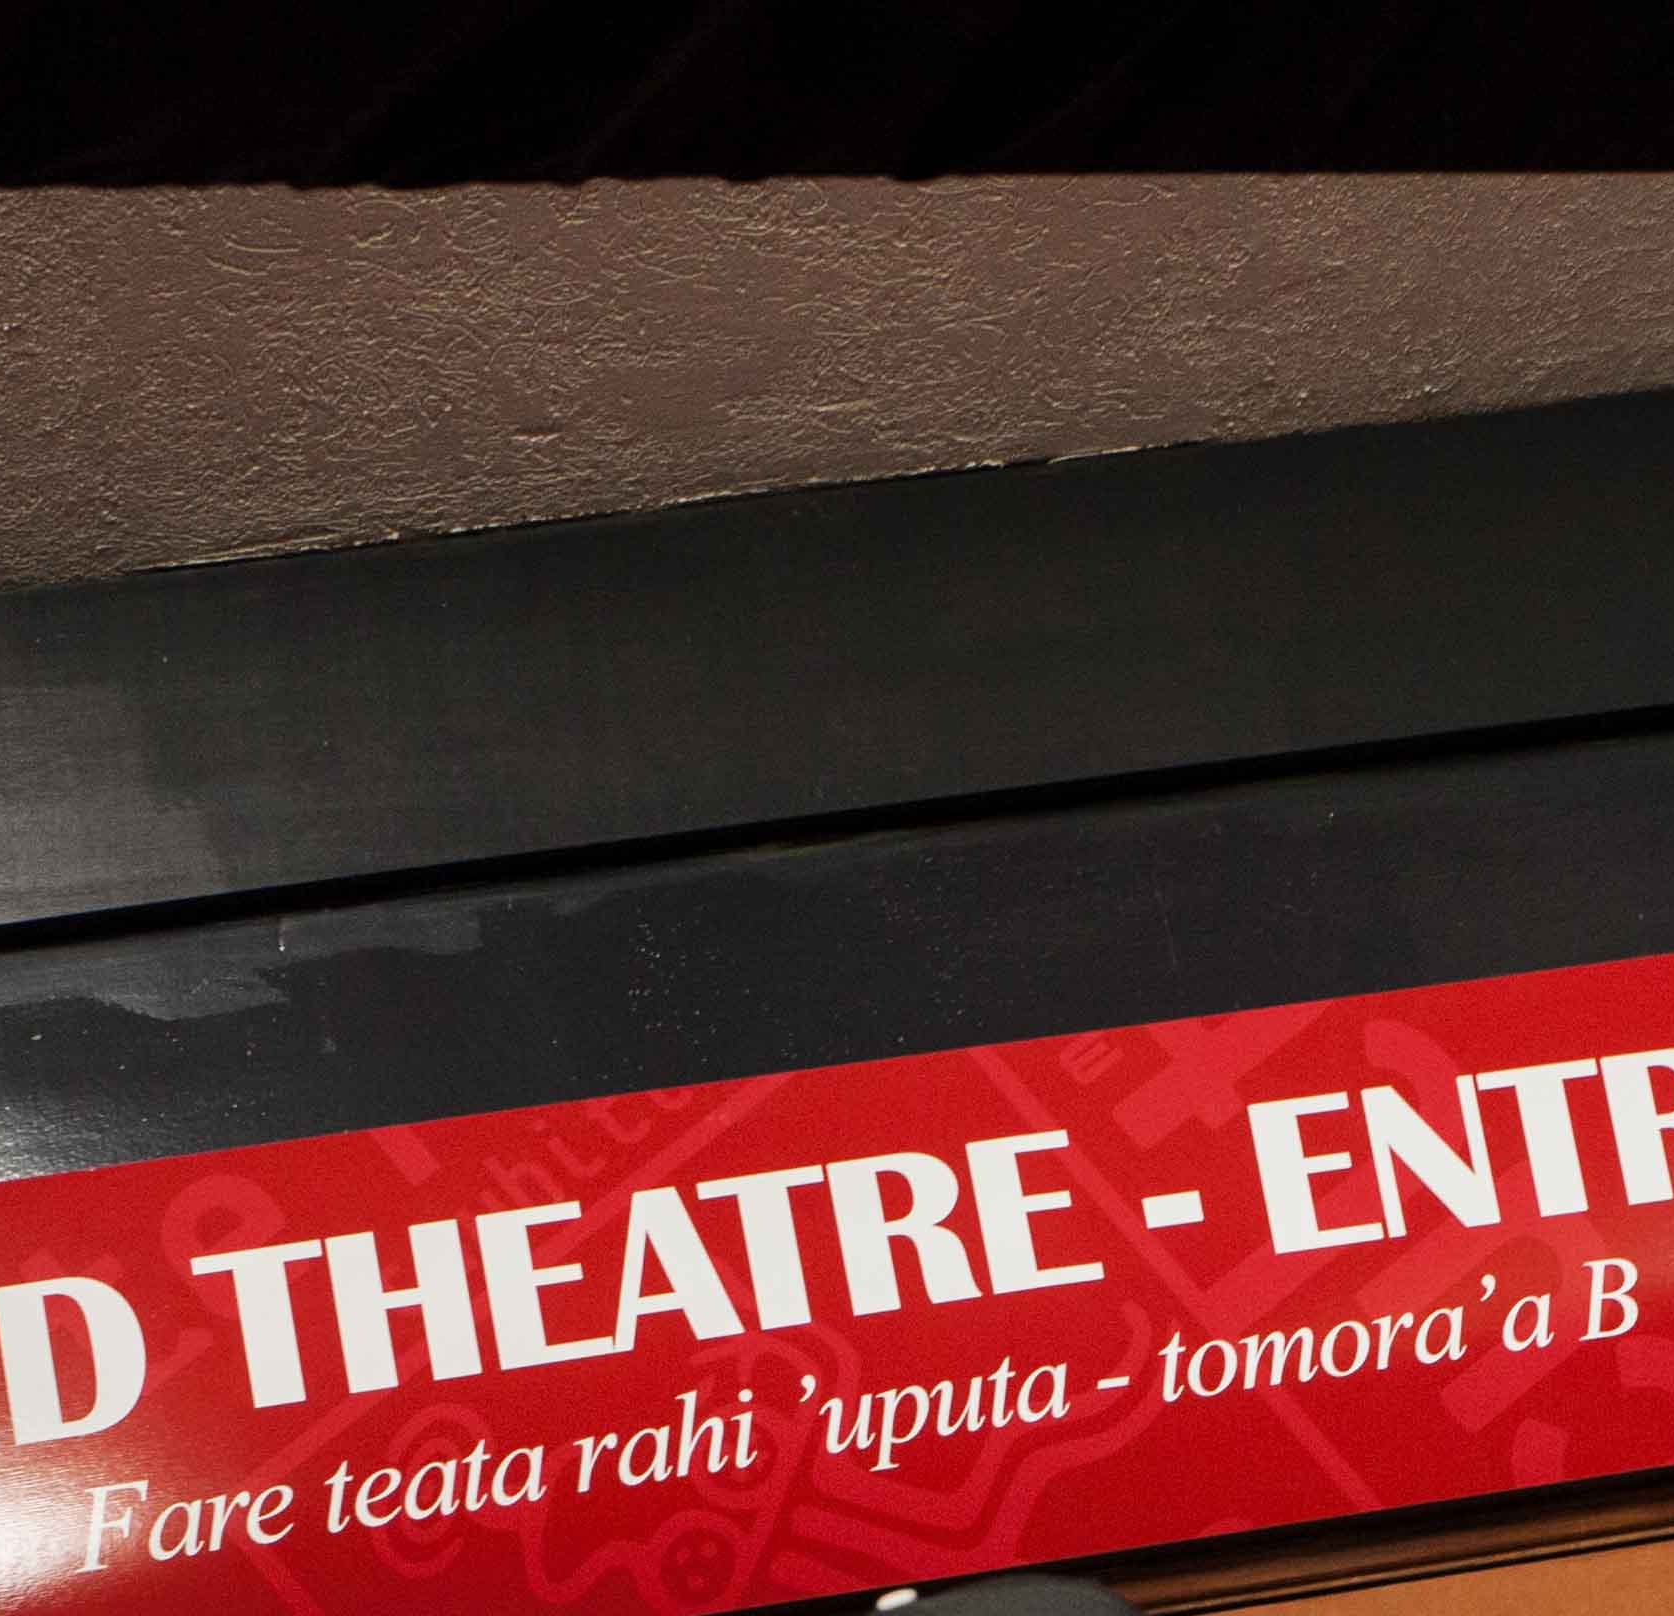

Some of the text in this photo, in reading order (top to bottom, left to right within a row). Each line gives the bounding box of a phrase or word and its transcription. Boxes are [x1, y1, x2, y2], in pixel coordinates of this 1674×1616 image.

[80, 1258, 1639, 1572] Fare teata rahi ’uputa - tomora’a B
[190, 1130, 1104, 1408] THEATRE
[1142, 1191, 1204, 1228] -
